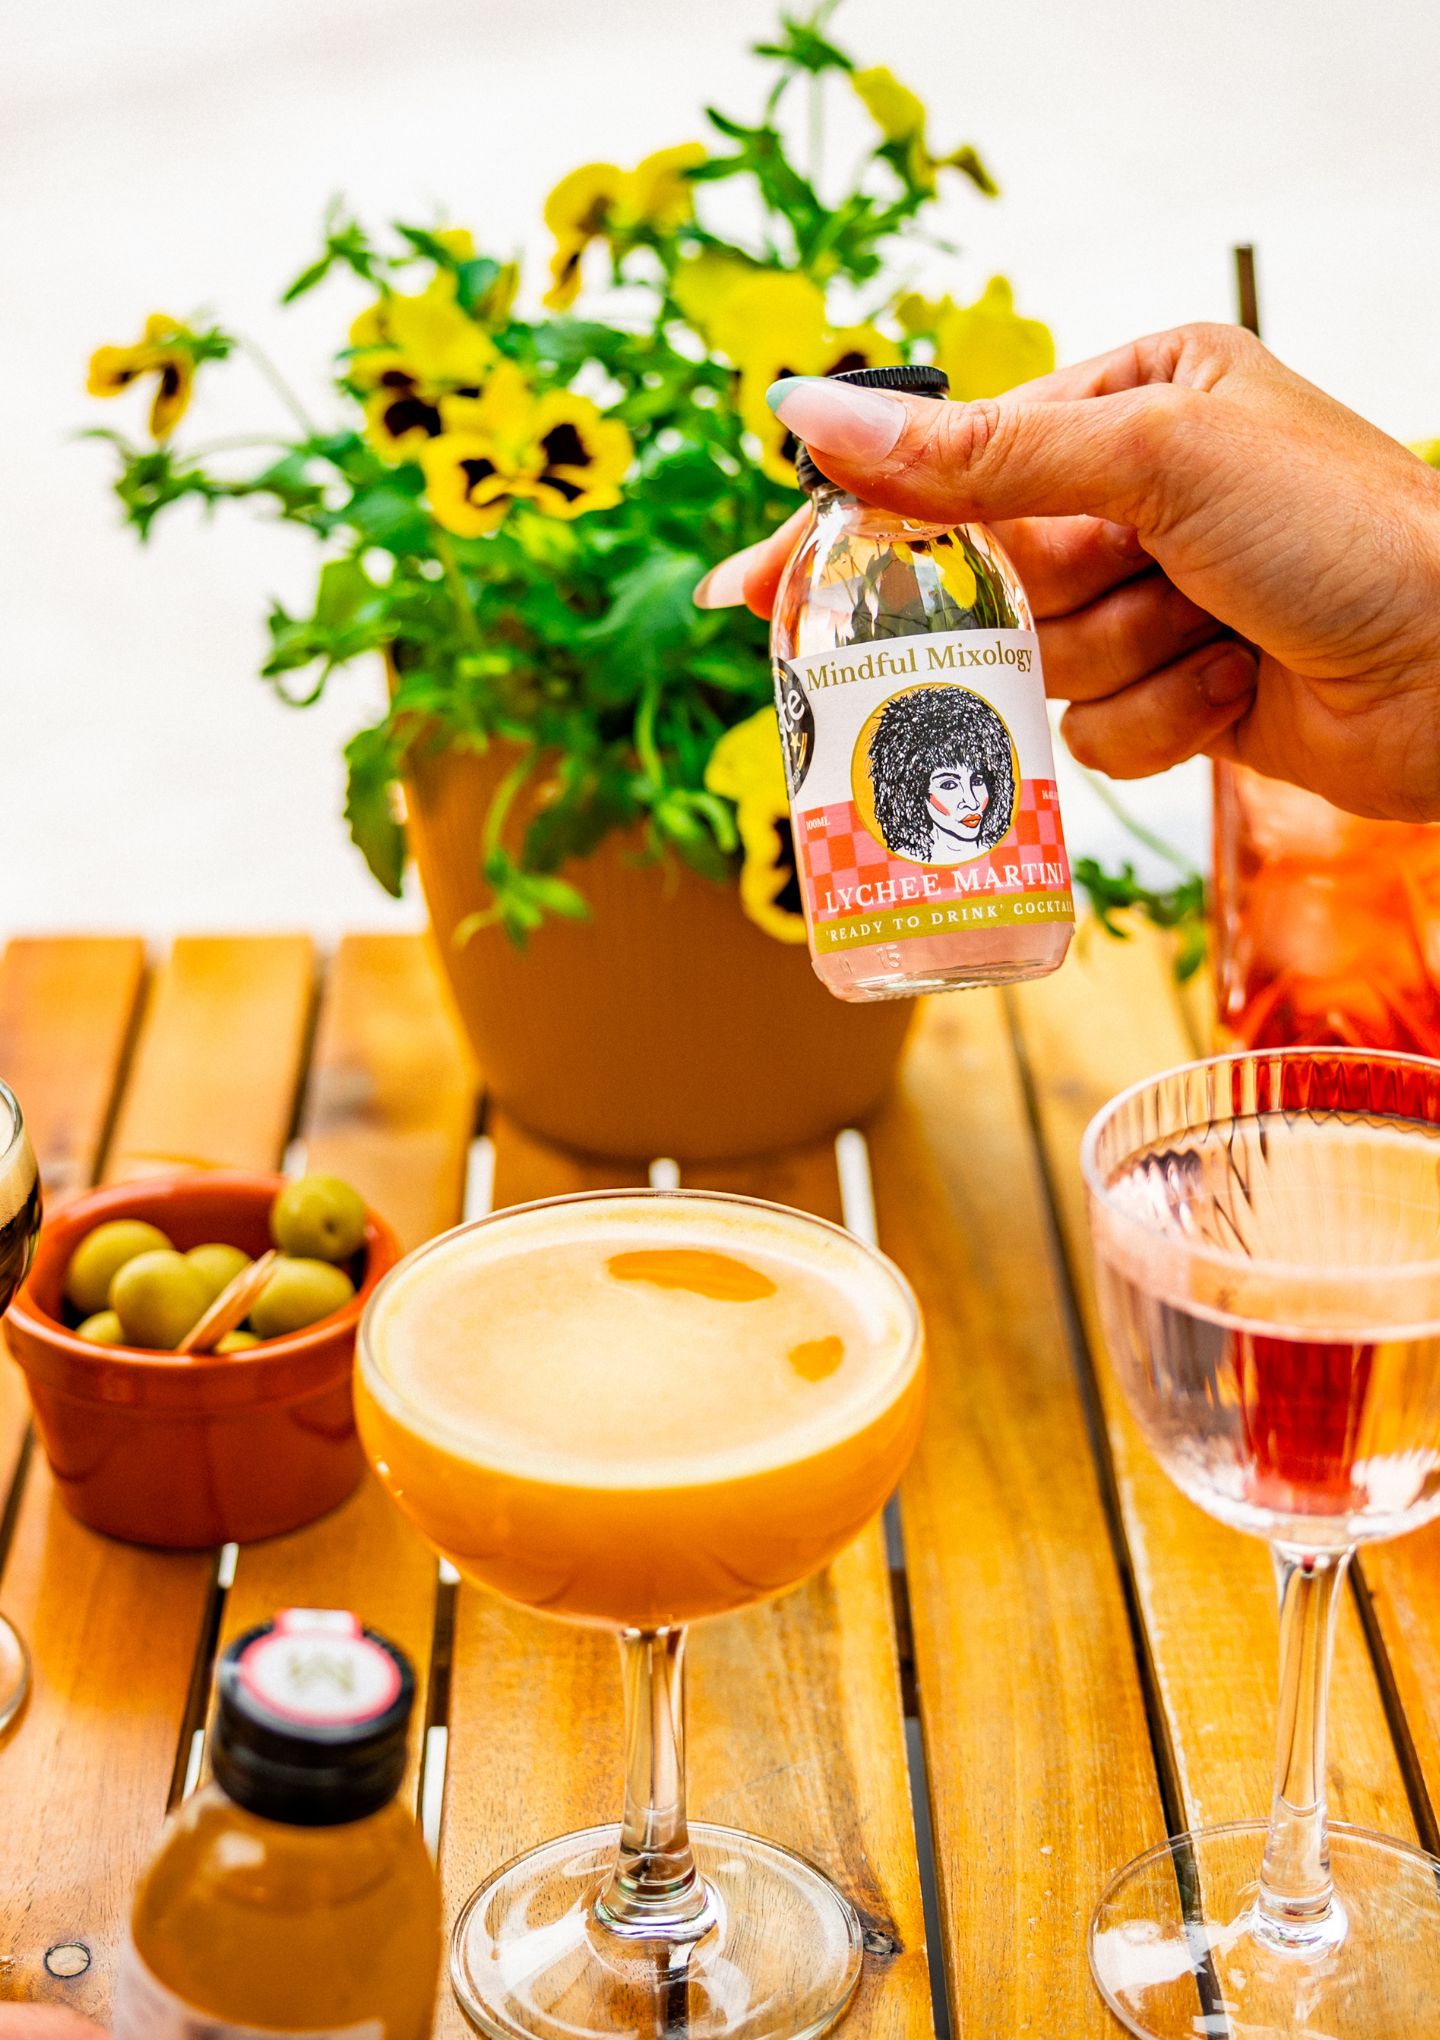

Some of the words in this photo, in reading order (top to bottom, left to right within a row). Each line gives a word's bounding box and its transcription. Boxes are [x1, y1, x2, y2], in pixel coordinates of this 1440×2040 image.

[805, 648, 918, 692] Mindful
[926, 640, 1033, 673] Mixology
[825, 873, 941, 914] LYCHEE
[951, 862, 1065, 893] MARTINI
[893, 916, 920, 931] TO
[931, 904, 1004, 925] DRINK'
